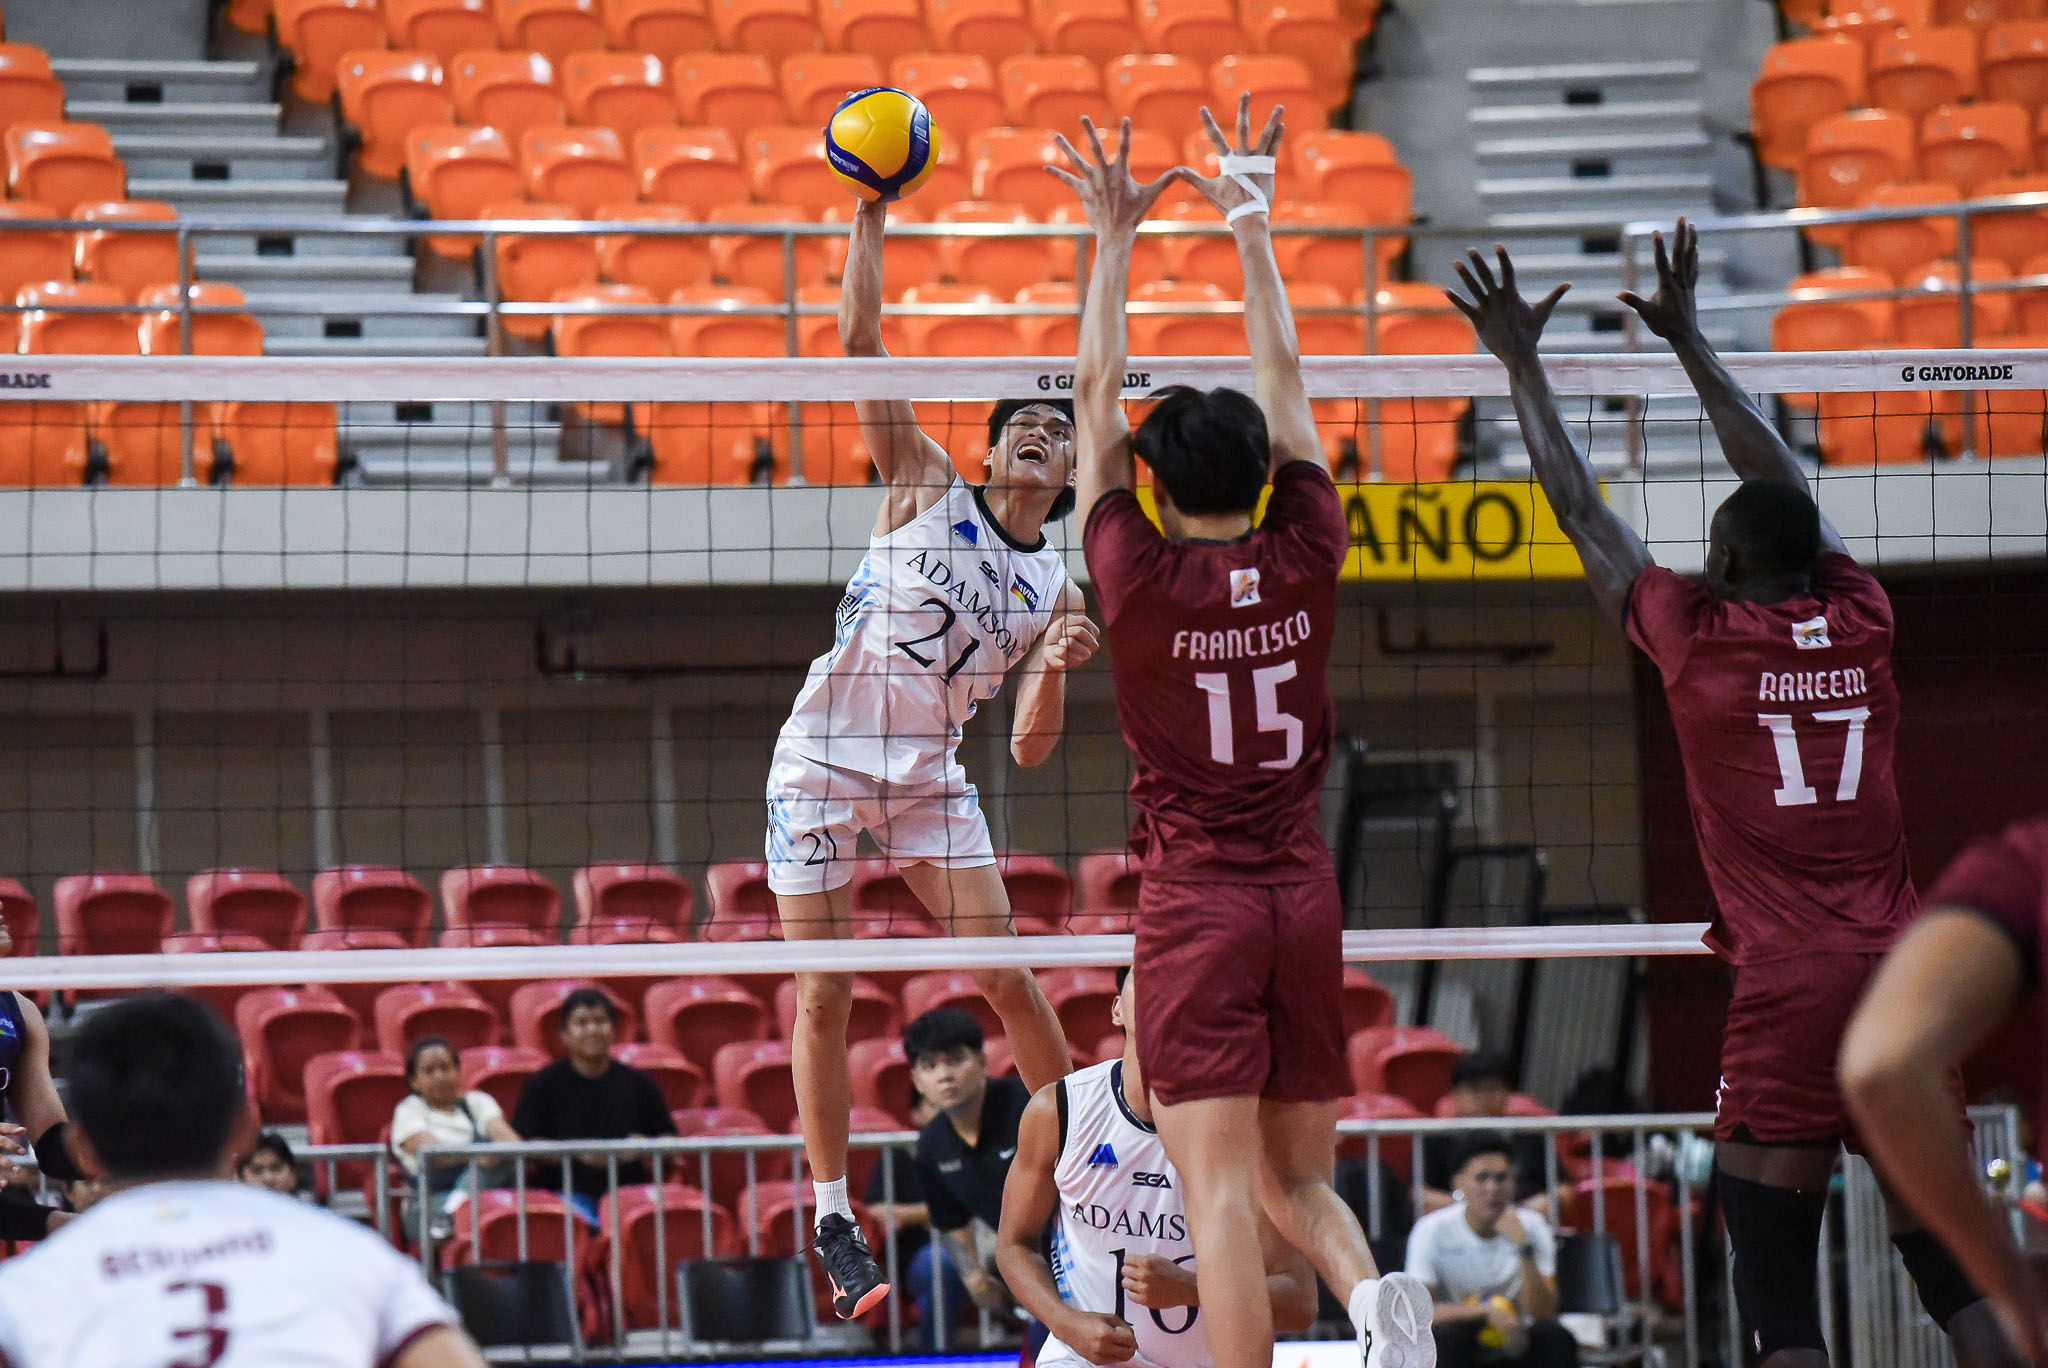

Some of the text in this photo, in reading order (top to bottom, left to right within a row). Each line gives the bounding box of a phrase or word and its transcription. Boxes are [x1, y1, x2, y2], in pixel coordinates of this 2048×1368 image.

[1901, 365, 2013, 383] G GATORADE
[894, 597, 981, 689] 21
[1171, 610, 1311, 661] FRANCISCO
[1759, 667, 1868, 702] RAHEEM
[1195, 660, 1303, 769] 15
[1757, 706, 1872, 807] 17
[801, 828, 839, 867] 21
[1072, 1202, 1186, 1242] ADAMS
[165, 1280, 230, 1368] 3
